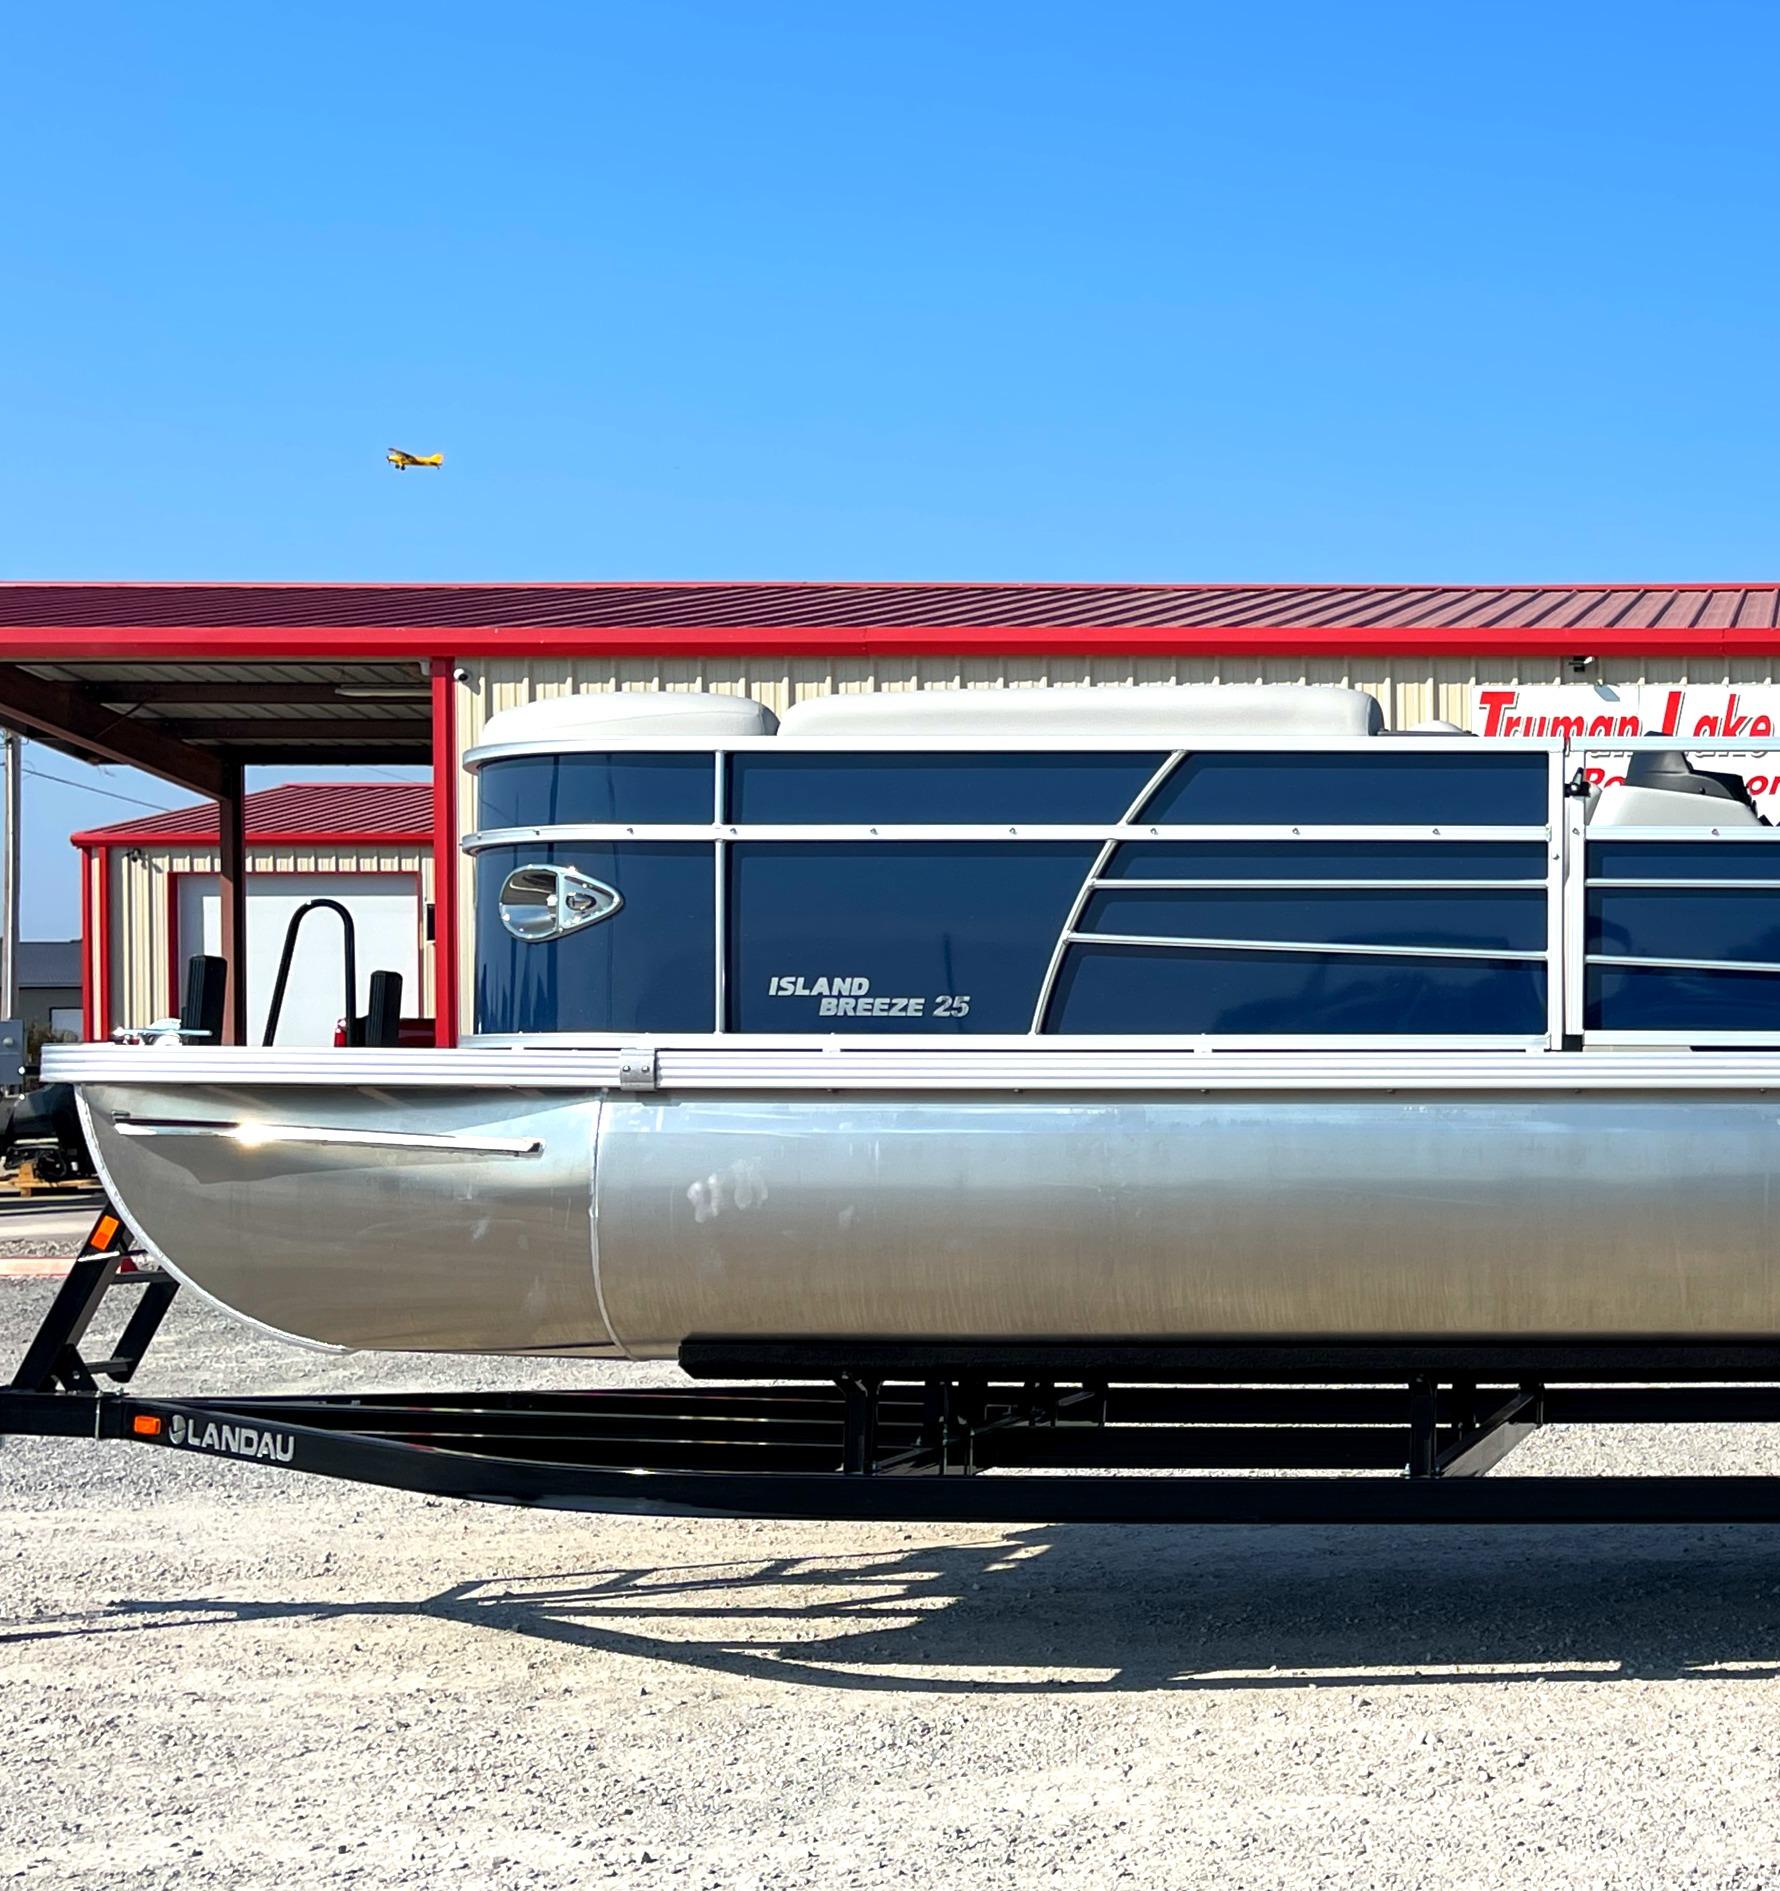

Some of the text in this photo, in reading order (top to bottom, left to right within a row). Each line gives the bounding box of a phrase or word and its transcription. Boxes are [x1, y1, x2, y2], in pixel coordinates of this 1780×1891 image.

[1479, 691, 1641, 740] Truman
[768, 976, 870, 996] ISLAND
[818, 995, 971, 1018] BREEZE 25
[187, 1418, 295, 1463] LANDAU
